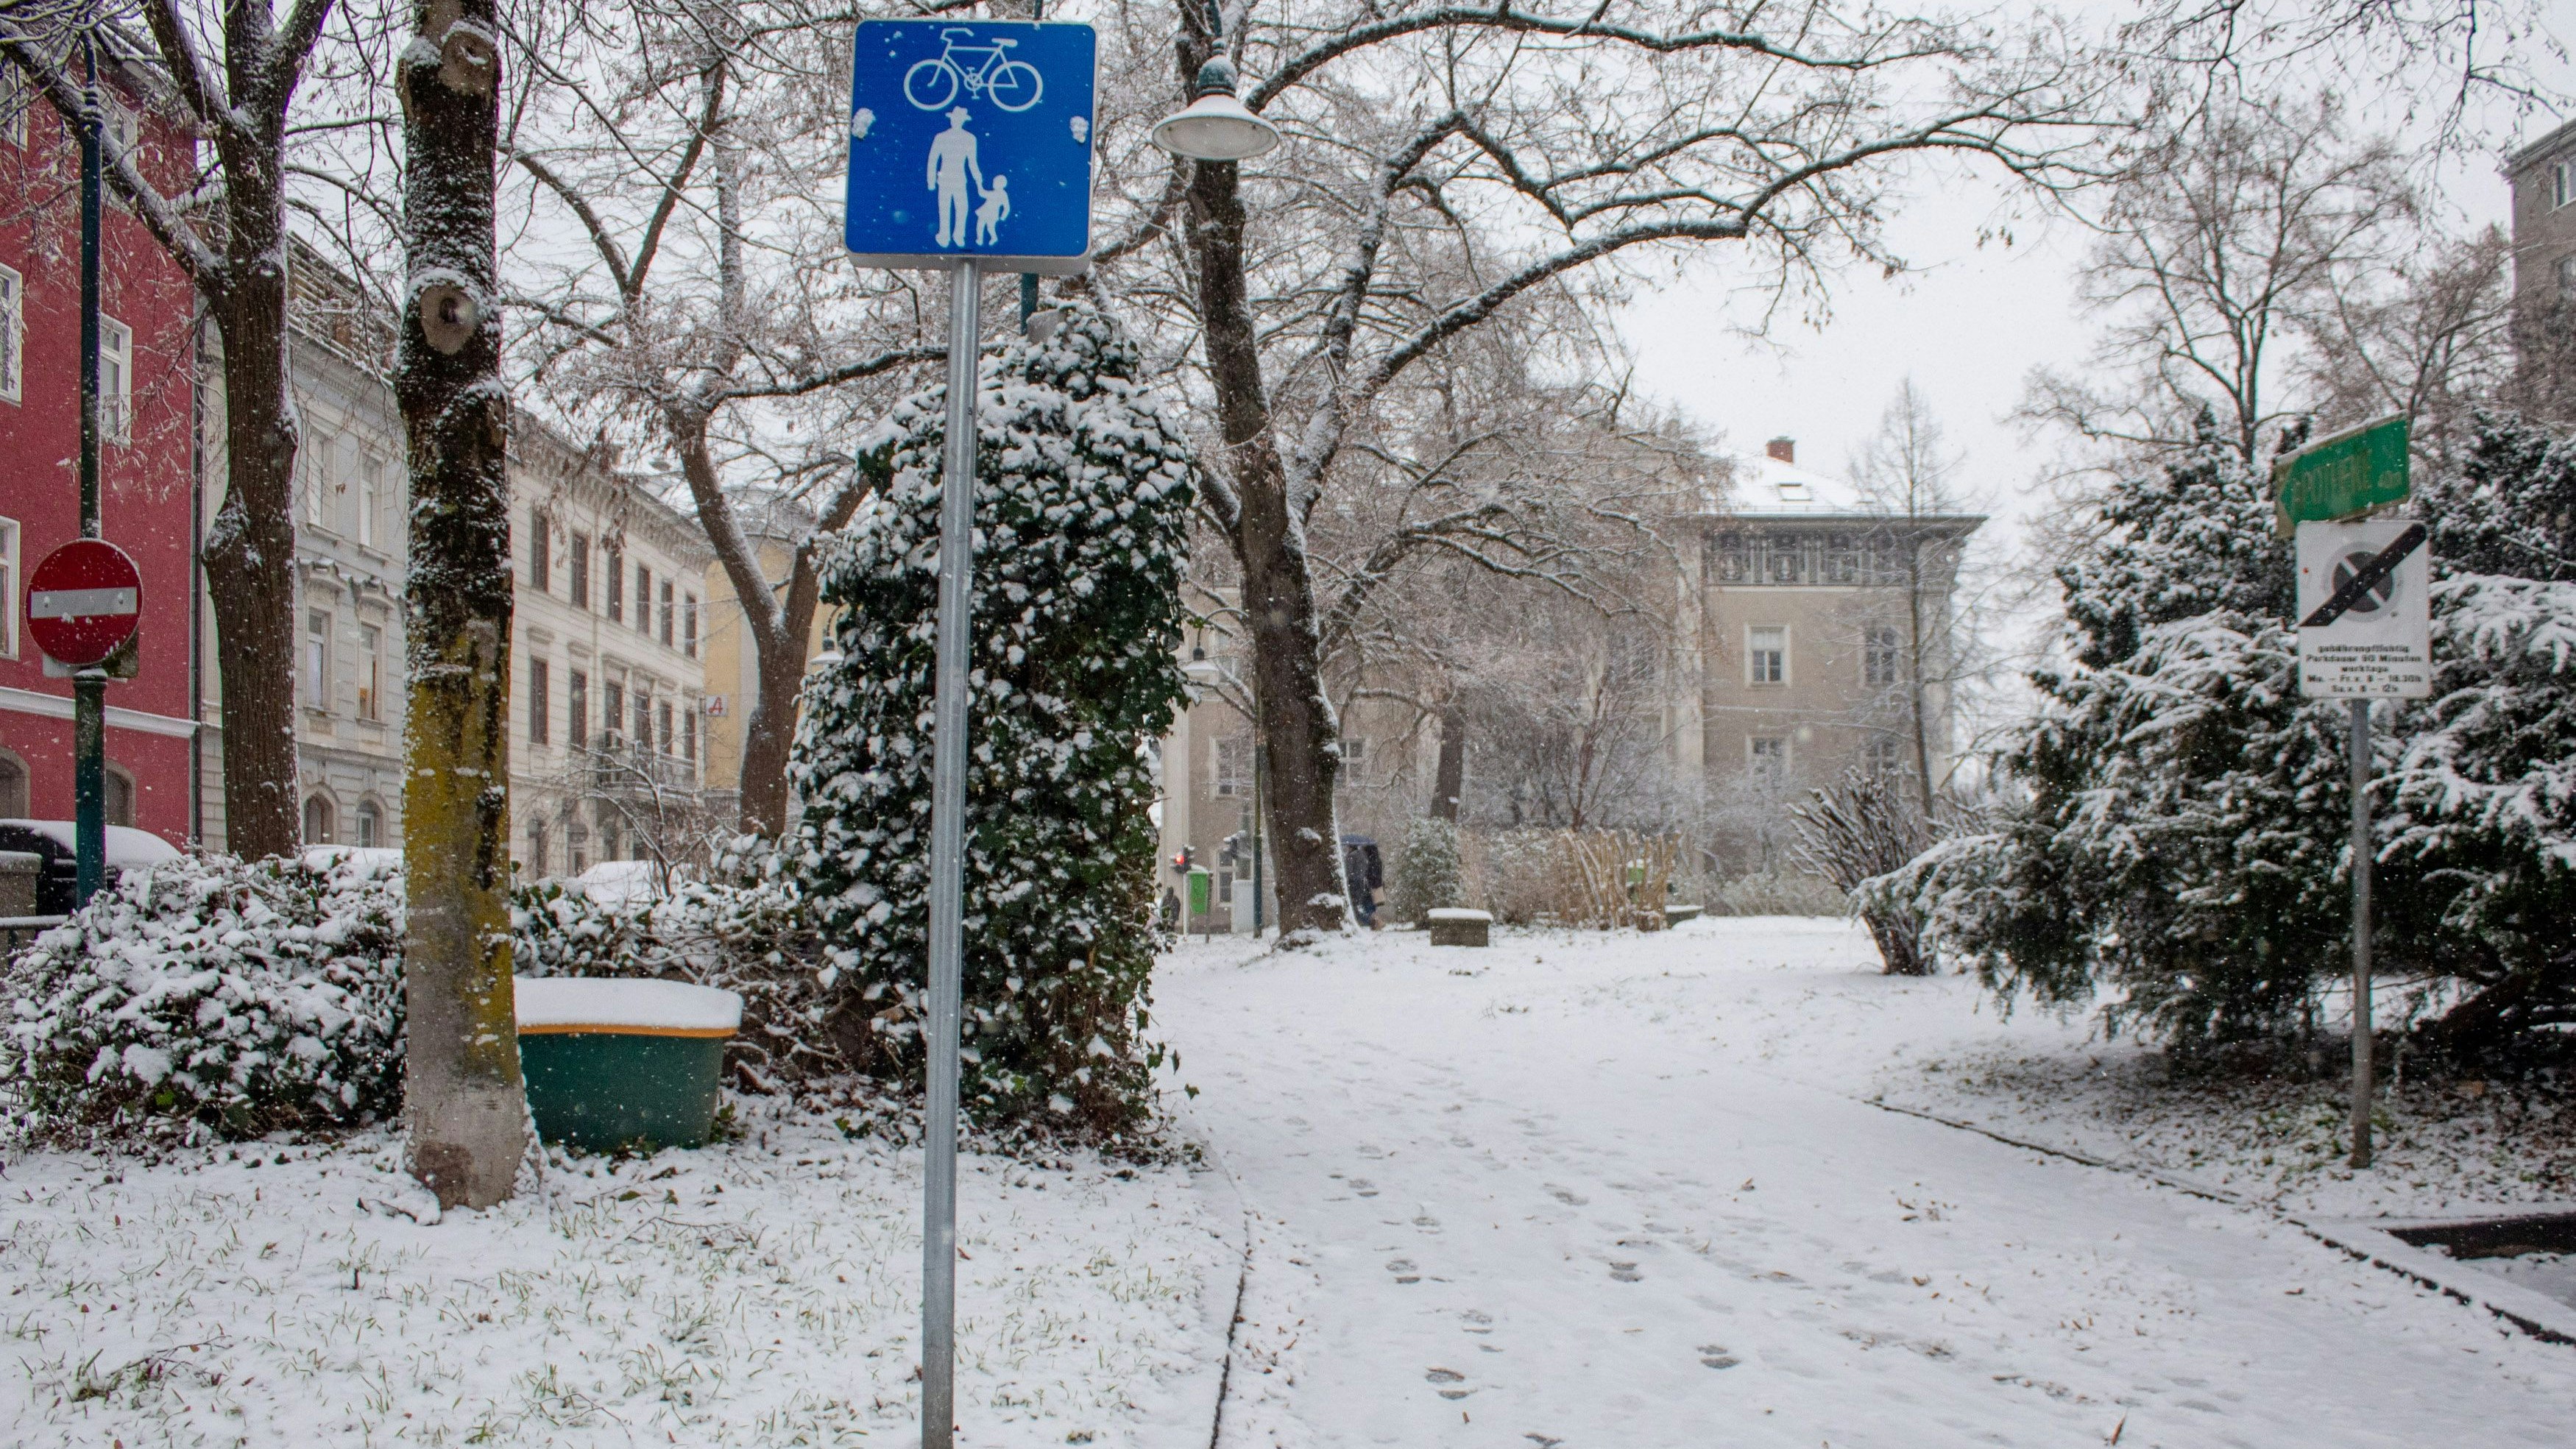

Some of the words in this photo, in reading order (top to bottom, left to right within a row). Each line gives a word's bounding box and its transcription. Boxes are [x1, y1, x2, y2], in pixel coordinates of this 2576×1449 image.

[2305, 653, 2357, 662] Parkdauer
[2378, 653, 2422, 662] Minuten
[2340, 665, 2389, 674] werktags
